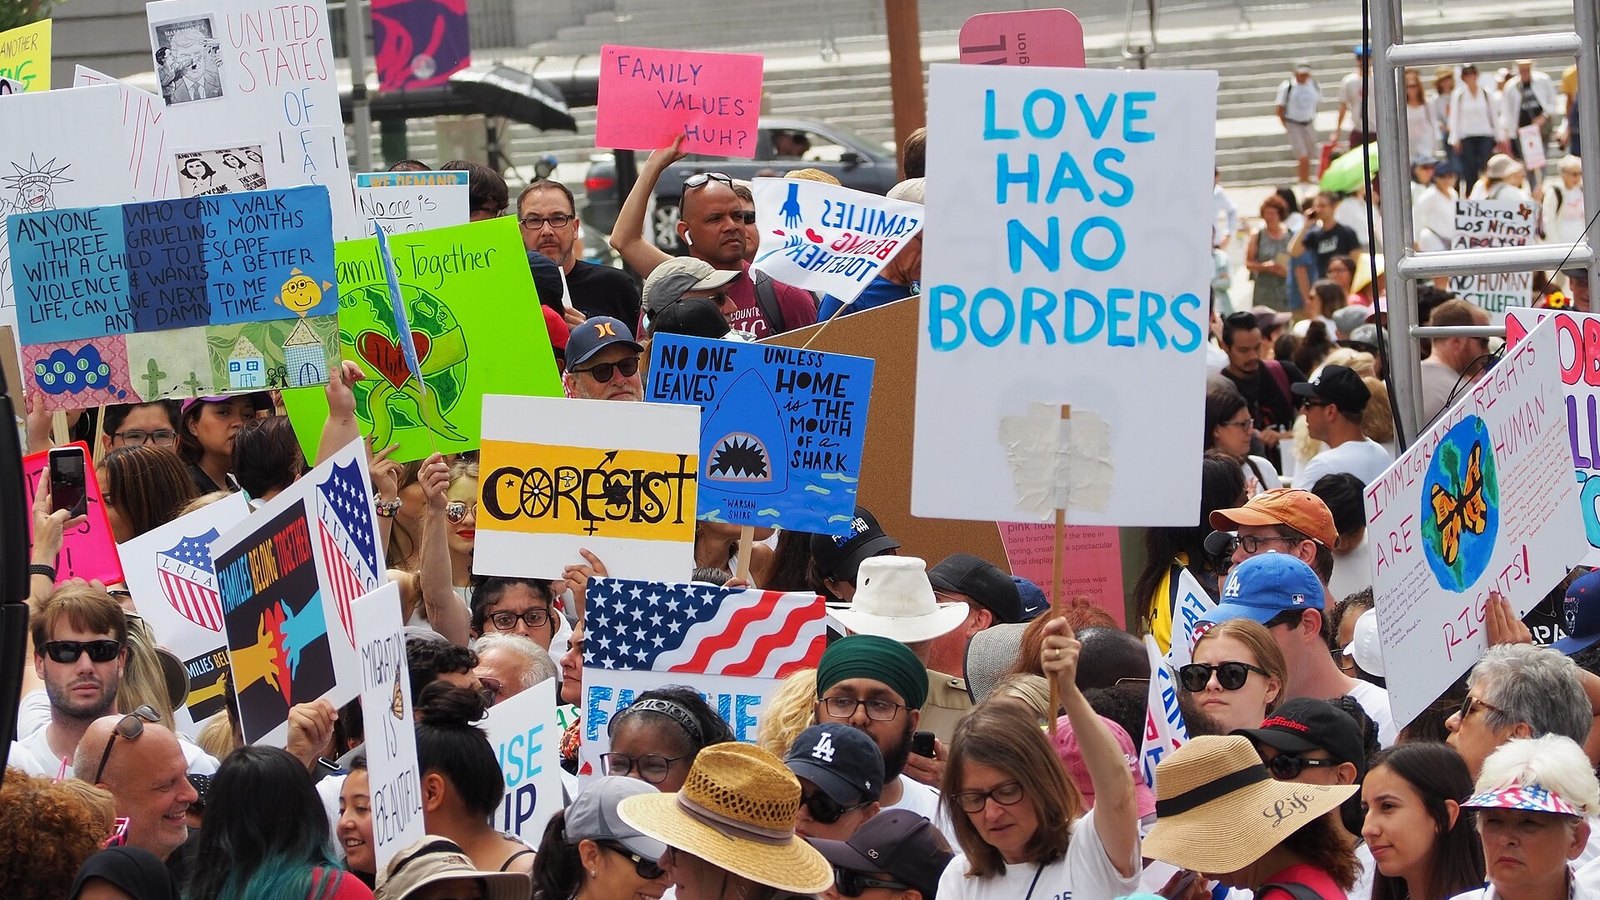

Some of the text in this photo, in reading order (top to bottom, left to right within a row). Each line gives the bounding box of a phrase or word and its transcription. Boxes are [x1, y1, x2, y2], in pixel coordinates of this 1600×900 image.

[227, 5, 319, 49] UNITED
[239, 38, 328, 92] STATES
[284, 87, 314, 127] OF
[983, 88, 1157, 143] LOVE
[684, 124, 748, 150] HUH?
[996, 147, 1135, 208] HAS
[16, 194, 287, 242] ANYONE WHO CAN WALK
[389, 199, 413, 216] one
[418, 194, 437, 212] is
[35, 210, 304, 261] THREE GRUELING MONTHS
[1007, 216, 1126, 274] NO
[23, 236, 271, 283] WITH A CHILD TO ESCAPE
[27, 275, 121, 303] VIOLENCE
[148, 264, 209, 287] WANTS
[223, 260, 234, 276] A
[243, 249, 315, 273] BETTER
[406, 244, 496, 290] Together
[29, 276, 266, 325] LIFE, CAN LIVE NEXT TO ME
[105, 295, 266, 334] ANY DAMN TIME.
[928, 285, 1202, 353] BORDERS
[660, 345, 824, 372] NO ONE UNLESS
[653, 371, 718, 402] LEAVES
[775, 369, 850, 398] HOME
[790, 416, 851, 437] MOUTH
[812, 399, 855, 420] THE
[1367, 404, 1466, 522] IMMIGRANT
[1472, 340, 1536, 415] RIGHTS
[1492, 383, 1546, 470] HUMAN
[797, 436, 812, 448] OF
[728, 510, 751, 520] SHIRE
[218, 515, 312, 615] FAMILIES BELONG TOGETHER
[1376, 514, 1413, 576] ARE
[162, 559, 213, 588] LULA
[1225, 570, 1241, 597] LA
[383, 712, 397, 761] IS
[812, 732, 836, 763] LA
[375, 764, 422, 847] BEAUTIFUL
[1263, 792, 1314, 828] Life
